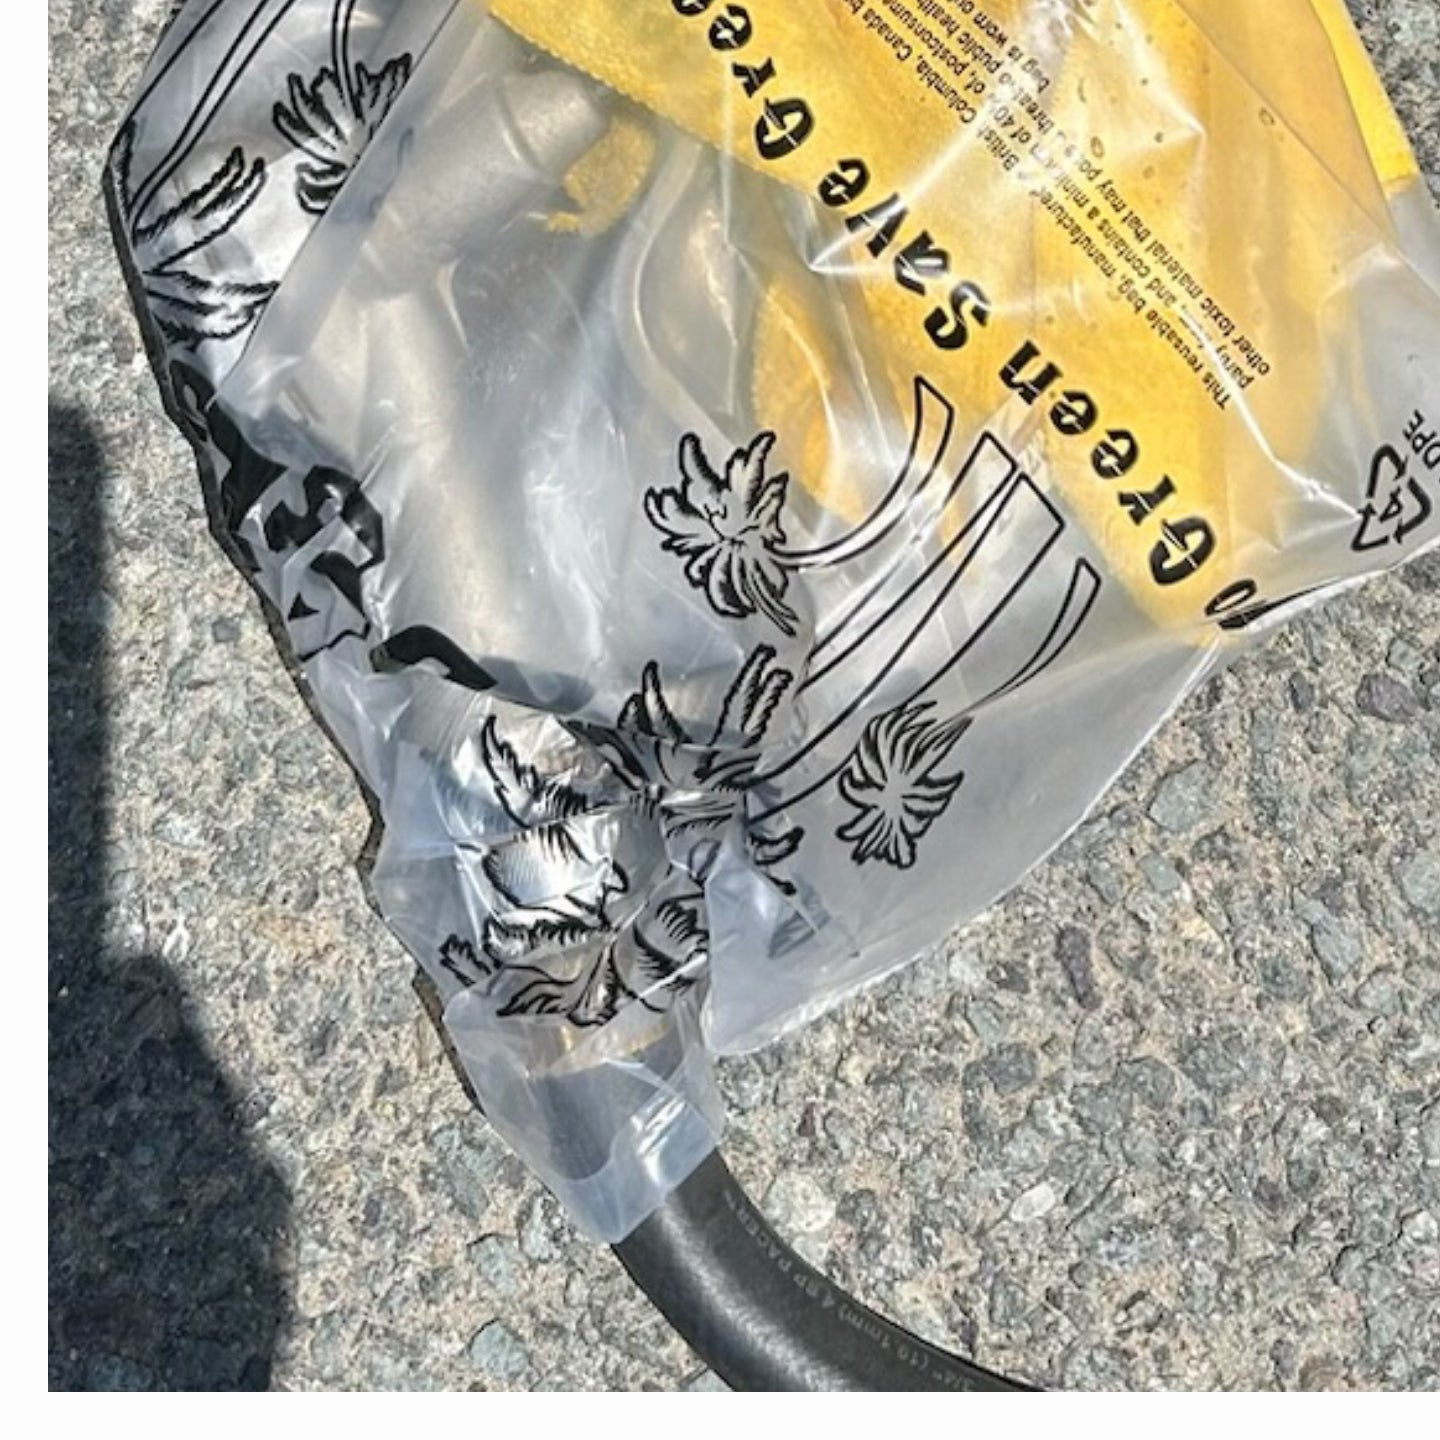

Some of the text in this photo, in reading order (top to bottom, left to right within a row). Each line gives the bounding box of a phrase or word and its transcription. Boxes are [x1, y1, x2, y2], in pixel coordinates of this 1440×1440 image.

[860, 7, 913, 60] Canada
[970, 11, 1008, 49] worn
[954, 28, 1002, 76] public
[1004, 44, 1023, 64] is
[910, 53, 978, 125] Columbia,
[1018, 58, 1052, 93] bag
[1008, 87, 1055, 136] threat
[1009, 124, 1032, 147] of
[1025, 142, 1090, 210] minium
[1061, 142, 1101, 182] poe
[1085, 206, 1099, 220] a
[1094, 177, 1130, 213] may
[1120, 210, 1152, 243] that
[818, 157, 993, 352] Save
[1093, 218, 1151, 281] contains
[1144, 239, 1203, 302] material
[1112, 272, 1150, 311] bag,
[1145, 276, 1177, 309] and
[1196, 296, 1236, 338] toxic
[1143, 307, 1205, 375] reusable
[1229, 333, 1272, 378] other
[1199, 371, 1233, 407] This
[999, 340, 1217, 587] Green
